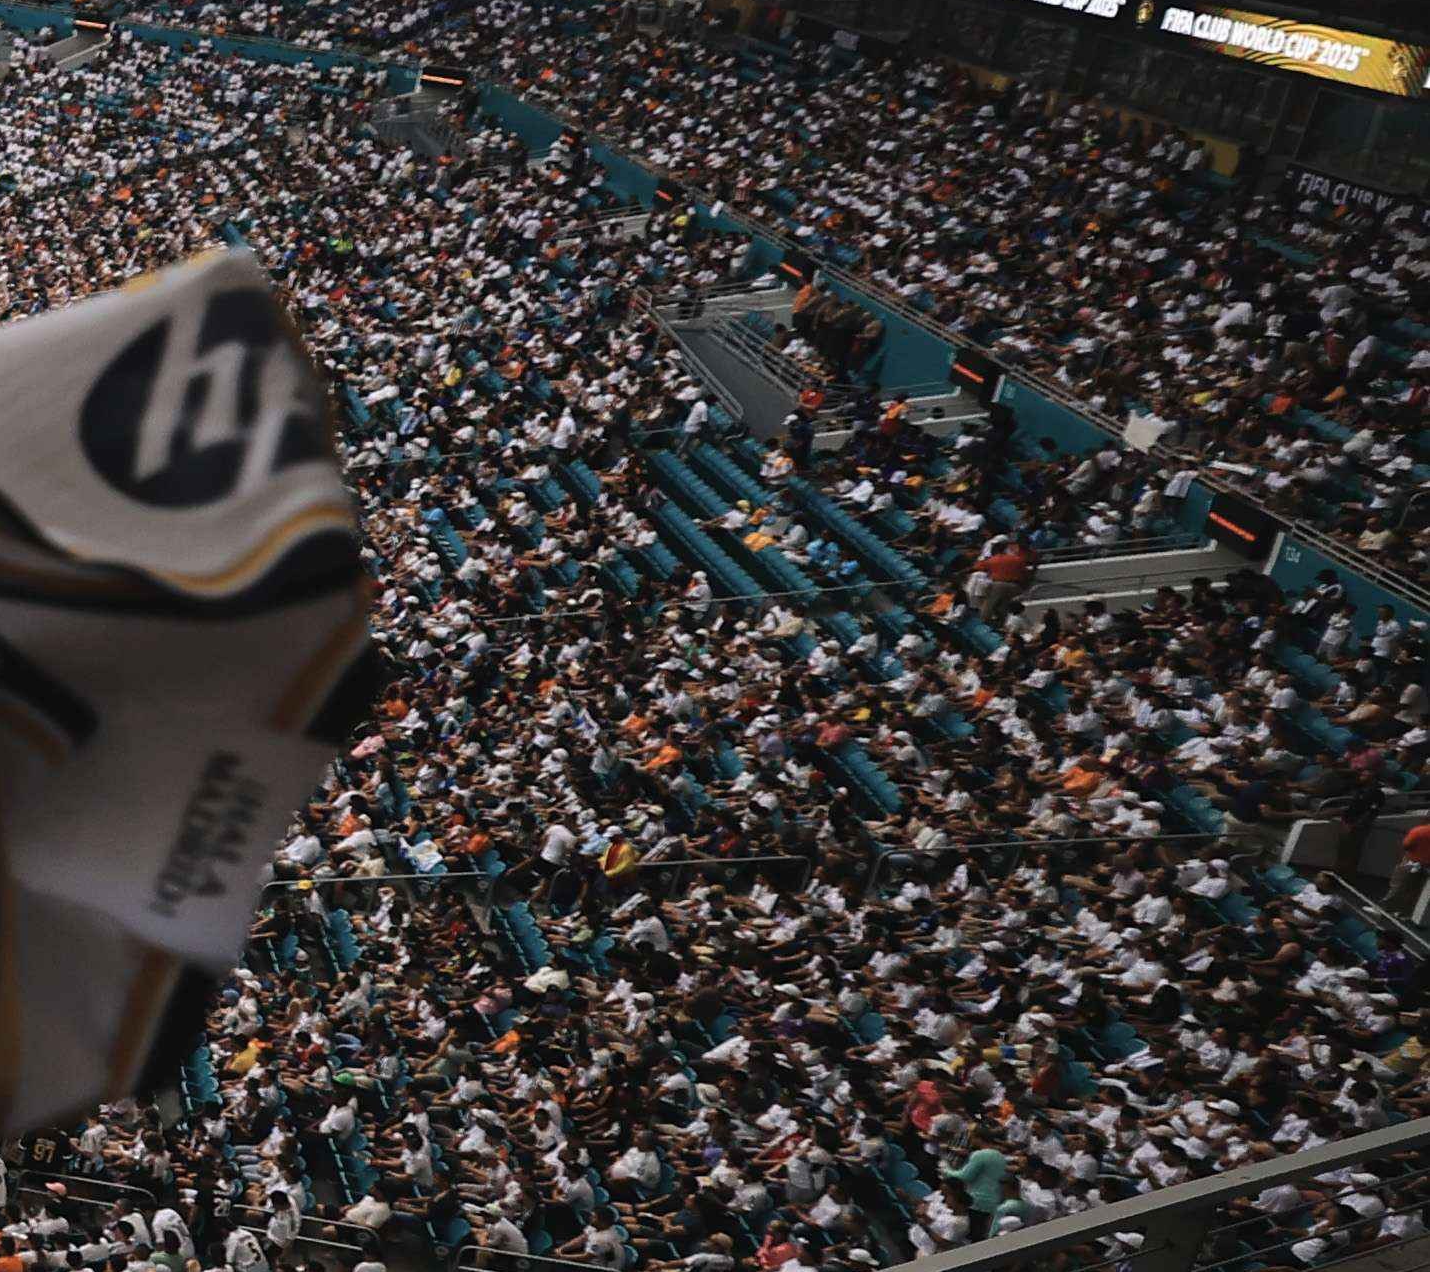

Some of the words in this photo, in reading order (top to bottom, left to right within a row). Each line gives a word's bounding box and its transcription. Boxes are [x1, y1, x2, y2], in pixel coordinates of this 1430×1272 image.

[1159, 6, 1195, 33] FIFA
[1193, 13, 1231, 41] CLUB
[1228, 18, 1287, 52] WORLD
[1283, 31, 1321, 59] CUP
